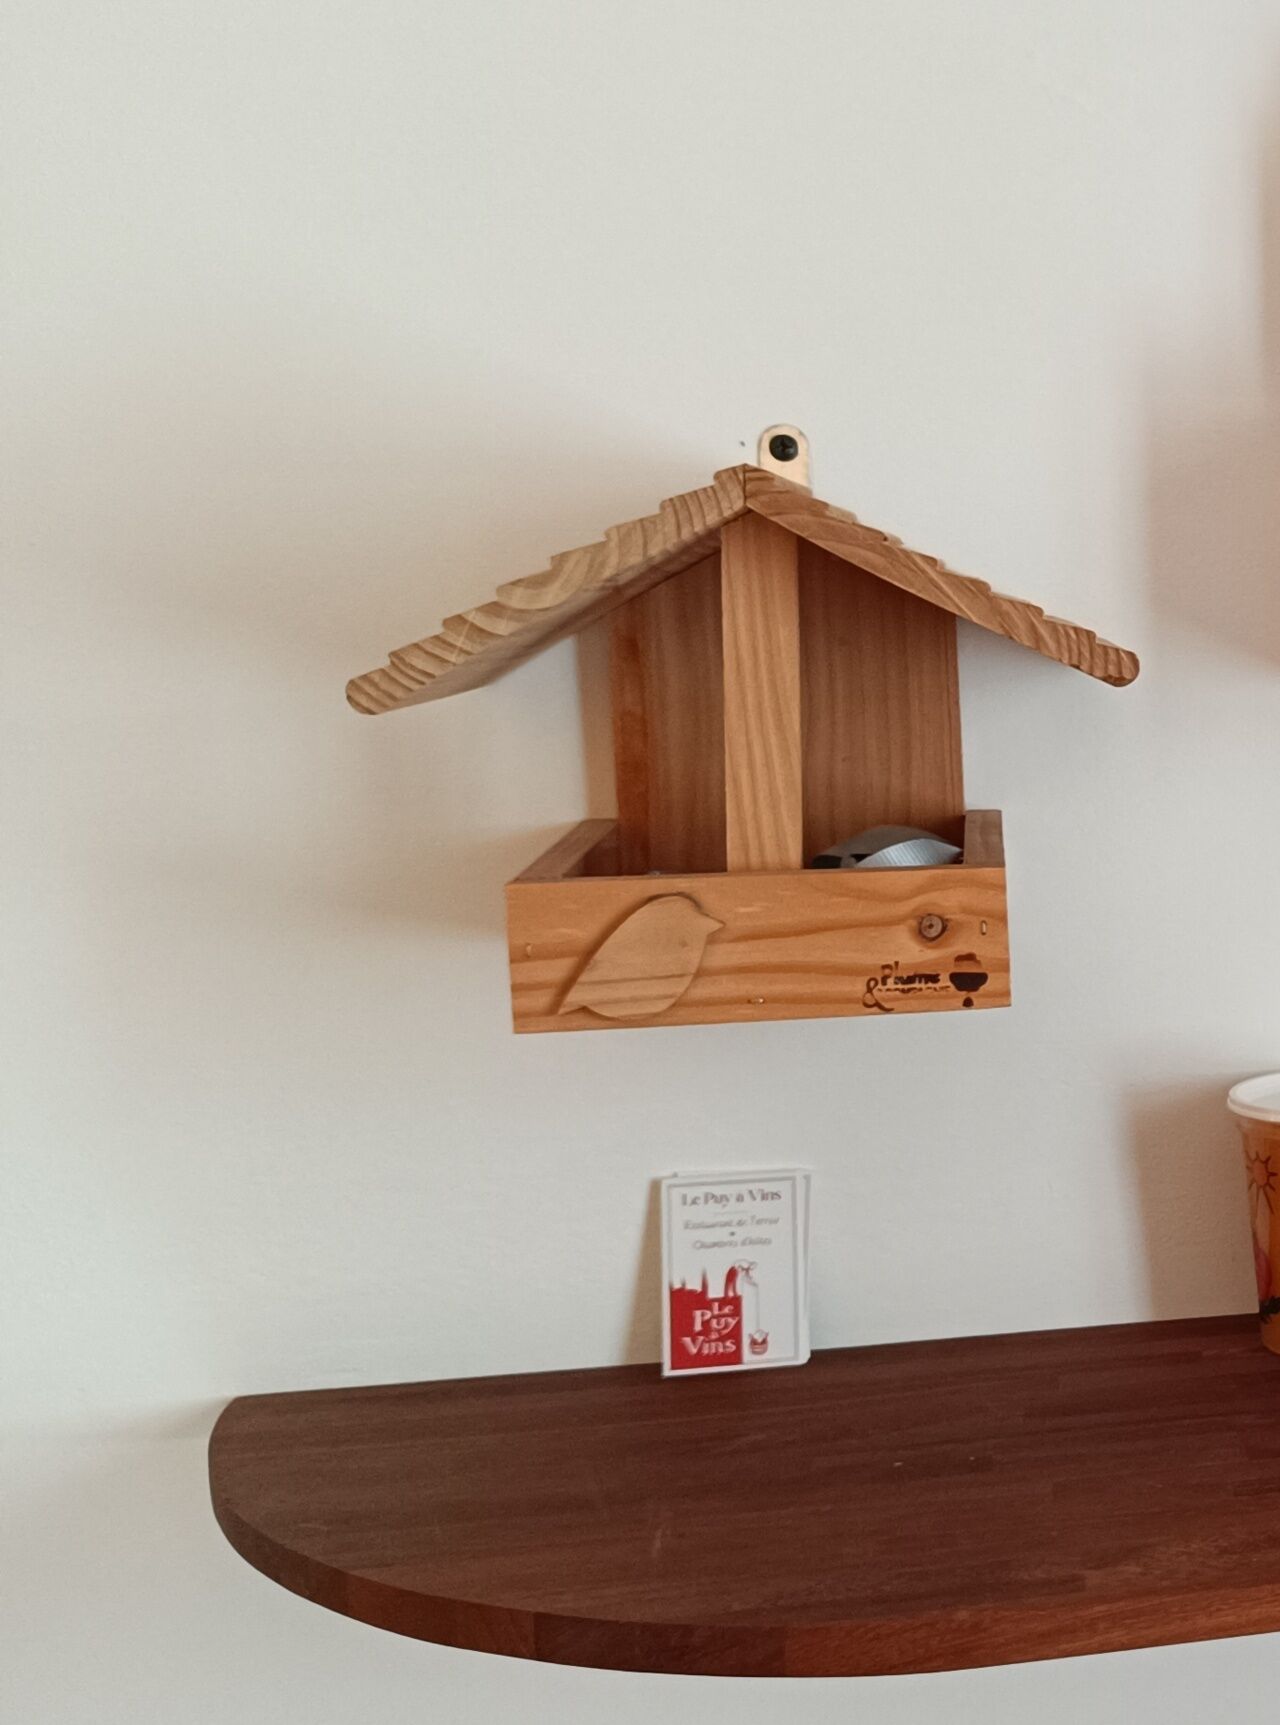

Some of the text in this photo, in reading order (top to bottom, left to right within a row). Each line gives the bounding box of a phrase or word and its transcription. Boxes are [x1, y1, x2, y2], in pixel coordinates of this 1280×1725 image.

[681, 1192, 701, 1206] Le
[704, 1191, 731, 1208] Puy
[748, 1188, 782, 1202] Vins
[712, 1302, 735, 1315] Le
[693, 1309, 740, 1336] Puy
[681, 1336, 737, 1356] Vins
